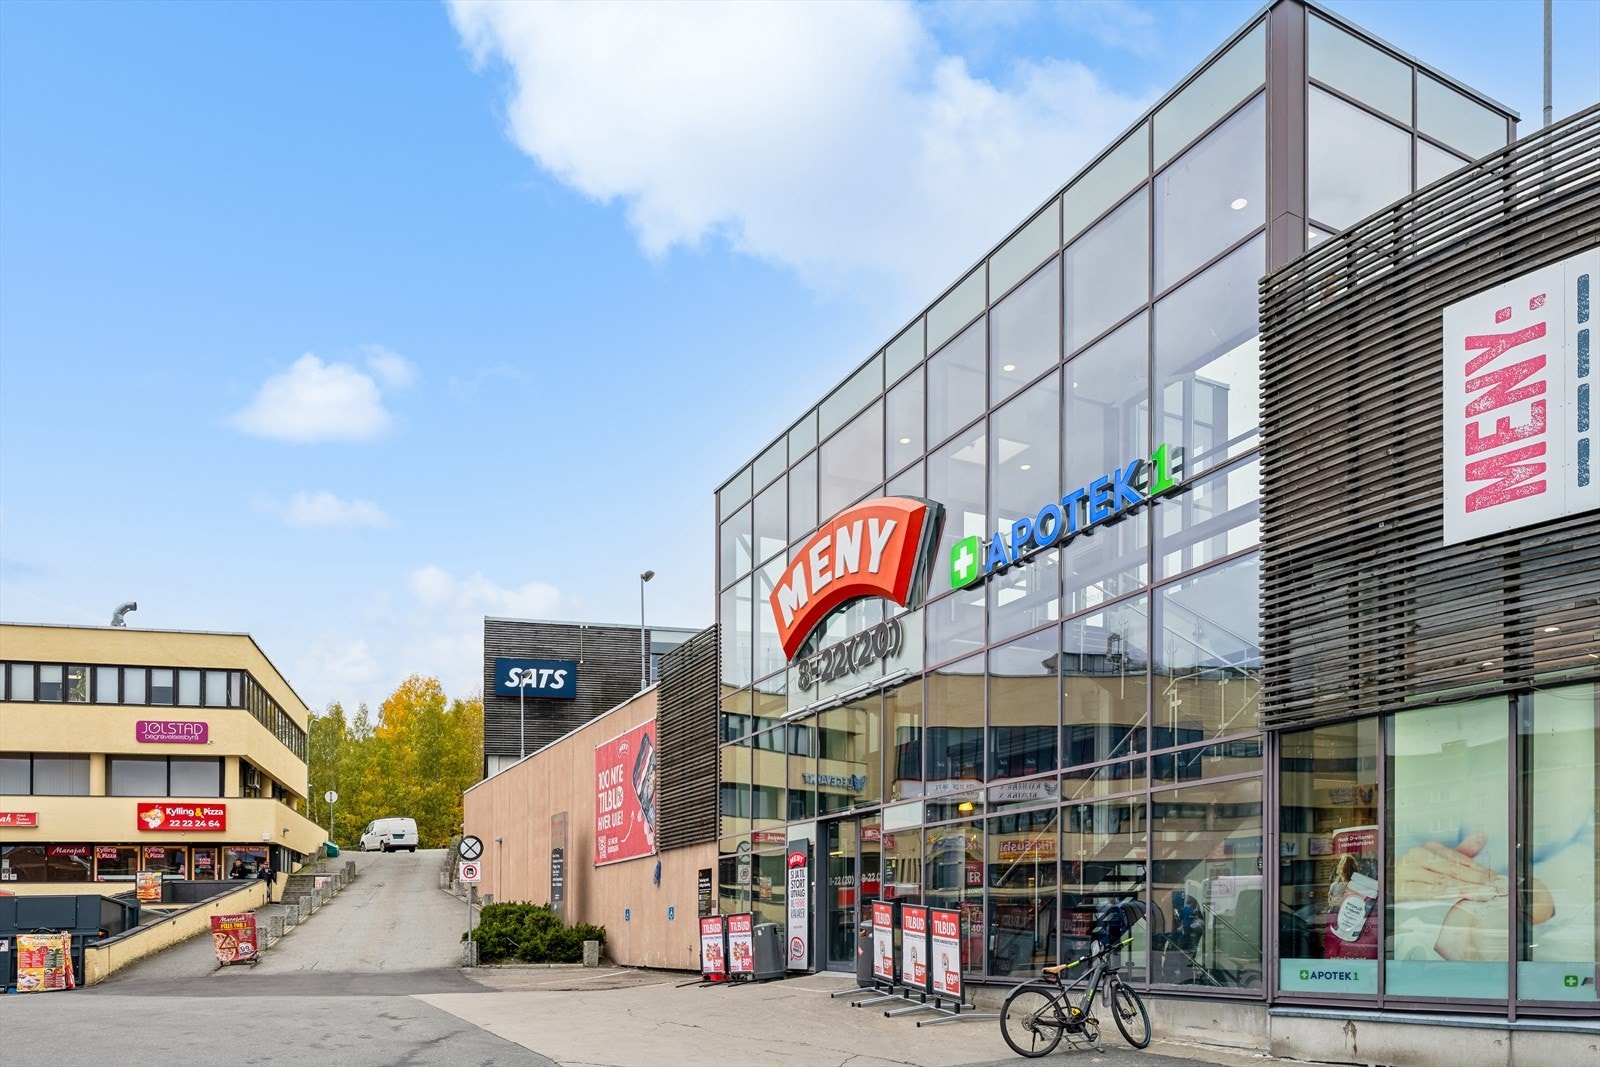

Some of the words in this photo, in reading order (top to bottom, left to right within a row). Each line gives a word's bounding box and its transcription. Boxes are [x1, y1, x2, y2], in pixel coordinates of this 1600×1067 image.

[985, 458, 1146, 574] APOTEK
[1149, 442, 1180, 495] 1
[777, 518, 897, 629] MENY
[504, 667, 568, 689] SATS
[141, 722, 203, 735] JØLSTAD
[144, 733, 199, 741] begravelsesbyrå
[598, 786, 624, 814] TILBUD
[166, 808, 194, 816] Kylling
[195, 808, 204, 818] &
[204, 808, 224, 816] Pizza
[598, 814, 611, 831] HVER
[52, 846, 86, 856] Marajah
[790, 854, 803, 865] MENY
[874, 912, 890, 925] TILBUD
[905, 916, 925, 930] TILBUD
[703, 923, 721, 934] TILBUD
[730, 922, 750, 932] TILBUD
[934, 920, 957, 936] TILBUD
[1310, 971, 1352, 980] APOTEK
[1353, 972, 1359, 980] 1
